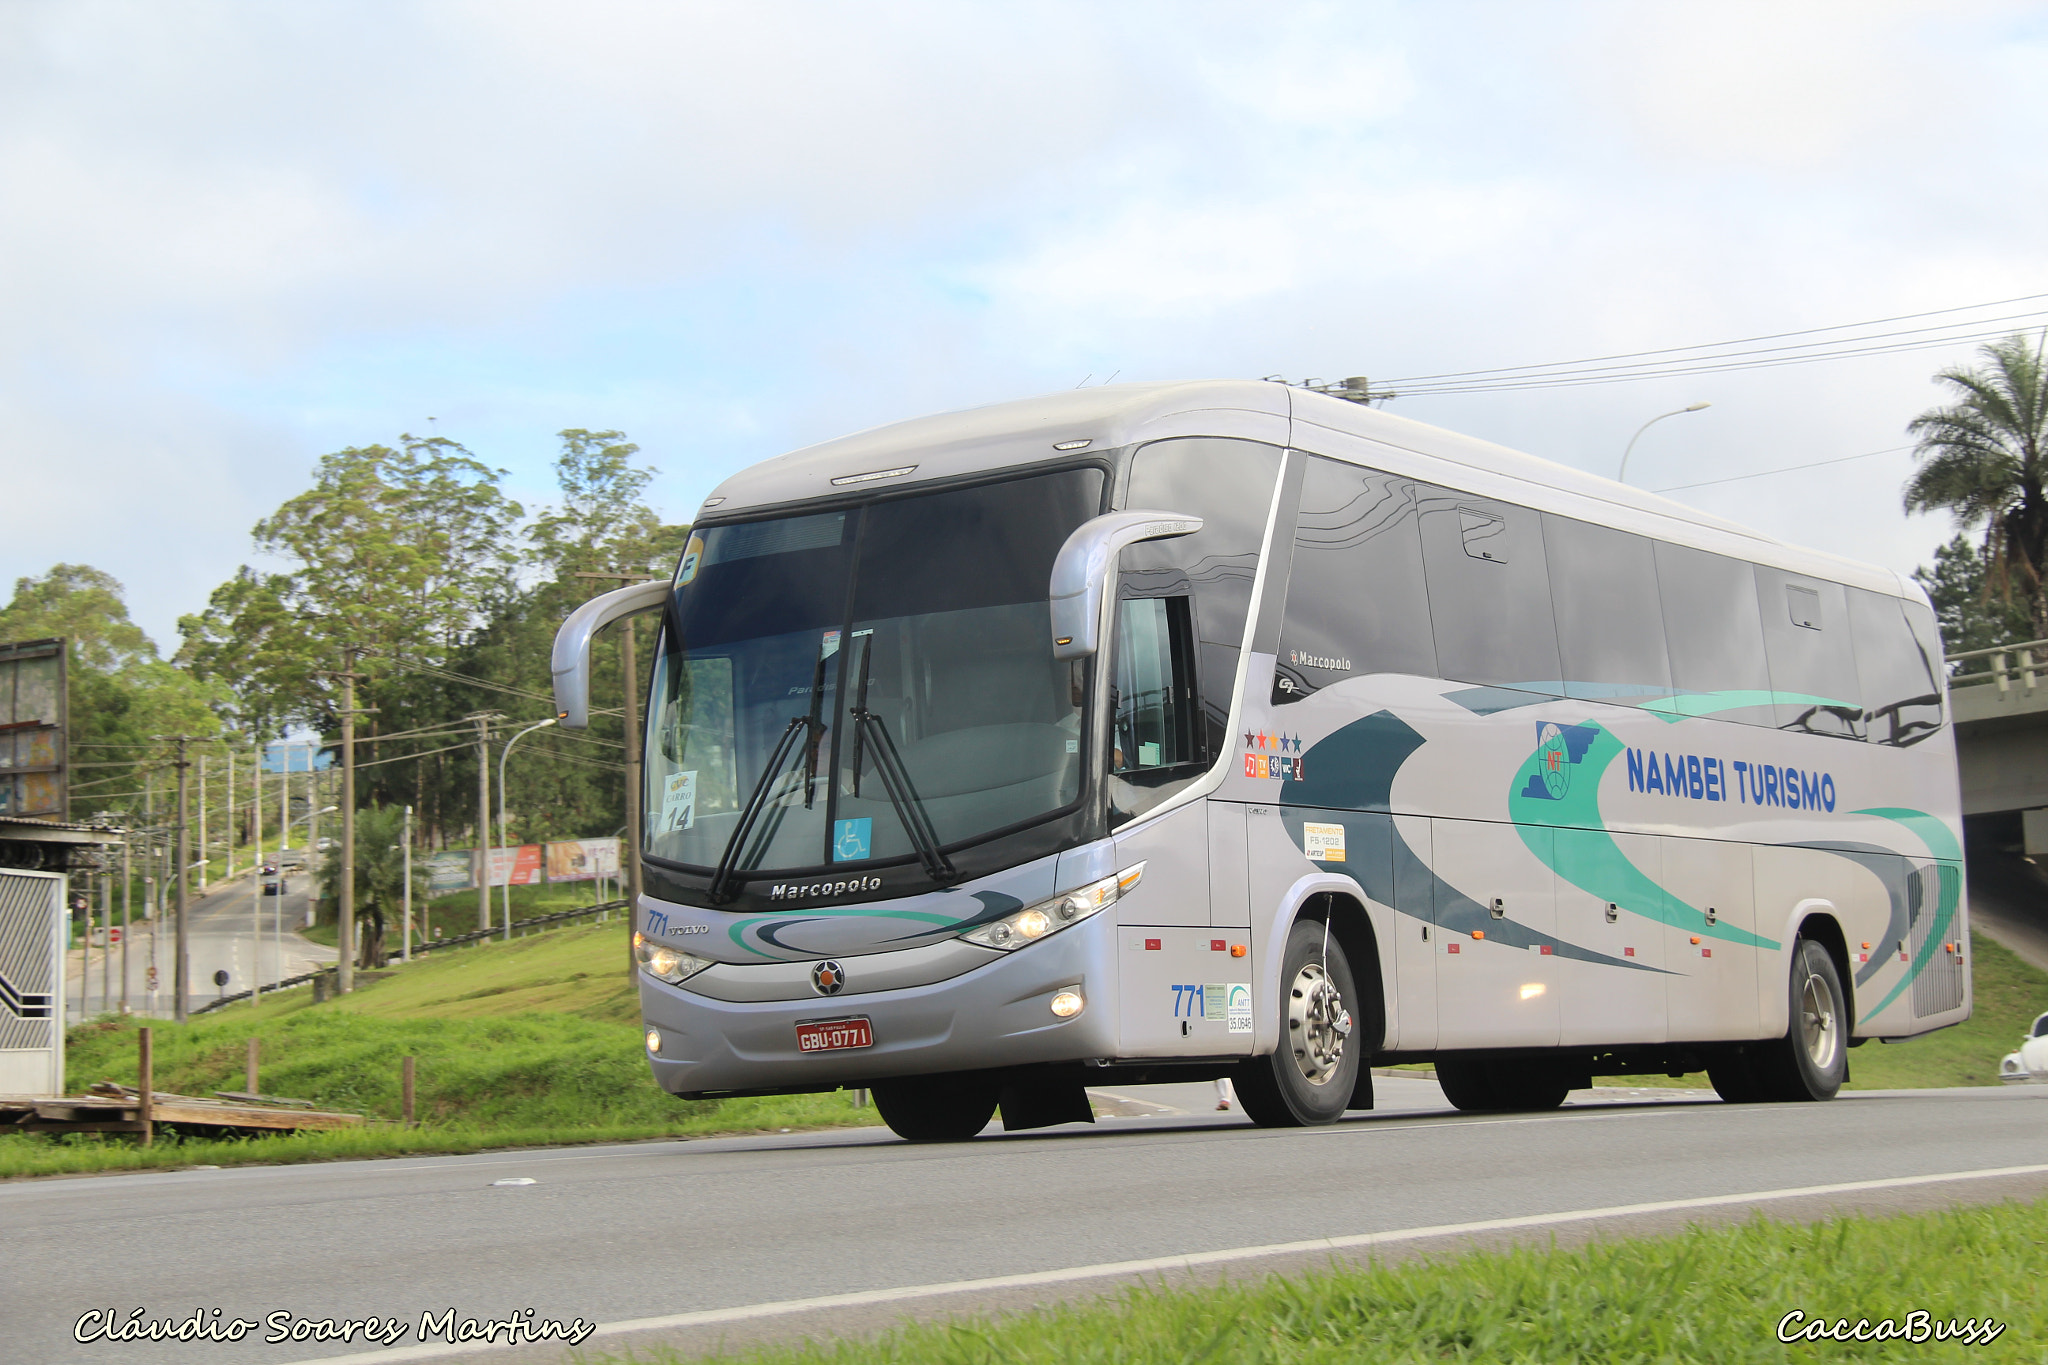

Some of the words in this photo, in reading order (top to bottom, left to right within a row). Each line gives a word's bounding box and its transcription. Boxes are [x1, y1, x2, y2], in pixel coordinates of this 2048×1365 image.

[679, 556, 695, 580] F
[1299, 650, 1351, 671] Marcopolo
[1547, 751, 1562, 772] NT
[1626, 746, 1727, 802] NAMBEI
[1732, 760, 1836, 813] TURISMO
[666, 791, 692, 803] CARRO
[668, 804, 691, 831] 14
[1305, 826, 1343, 836] FRETAMENTO
[770, 876, 881, 900] Marcopolo
[647, 910, 669, 936] 771
[669, 924, 709, 935] VOLVO
[1171, 984, 1205, 1017] 771
[1237, 998, 1250, 1007] ANTT
